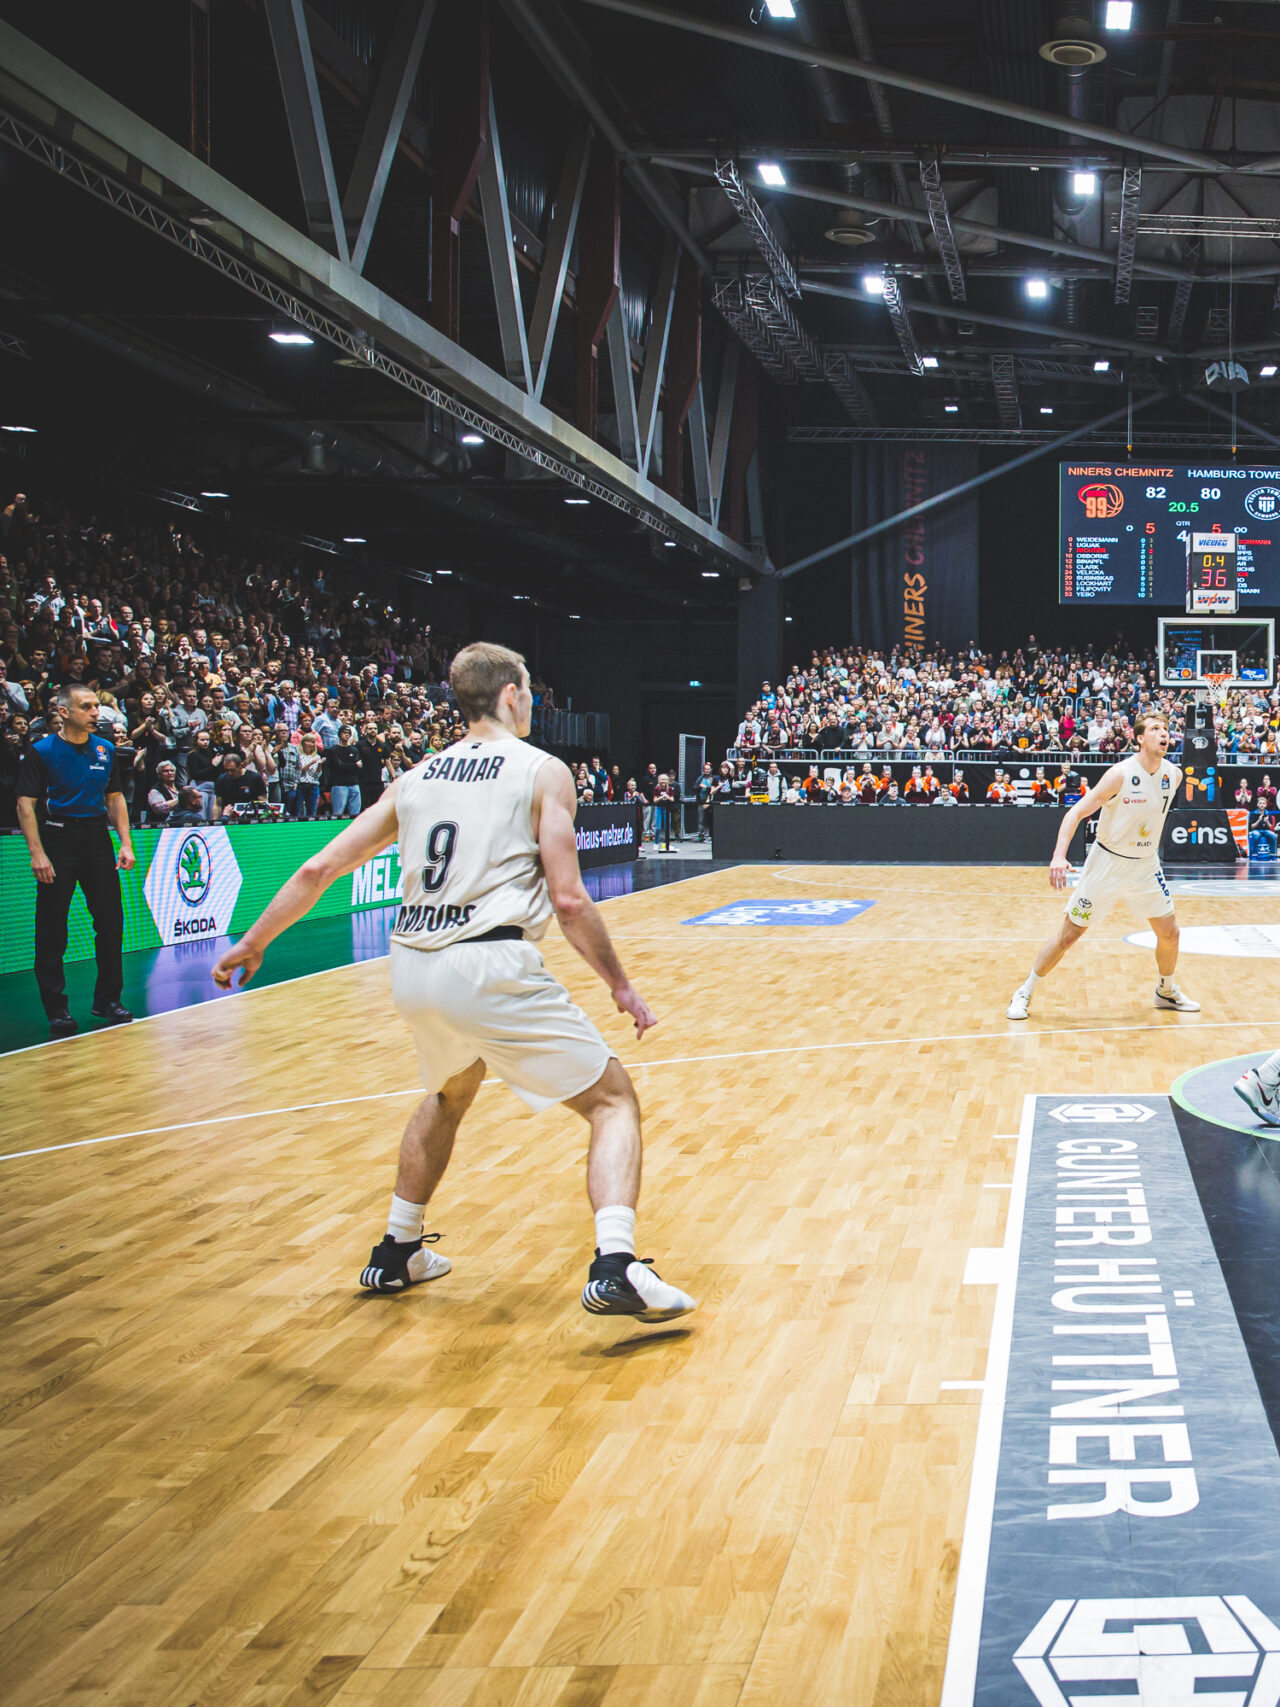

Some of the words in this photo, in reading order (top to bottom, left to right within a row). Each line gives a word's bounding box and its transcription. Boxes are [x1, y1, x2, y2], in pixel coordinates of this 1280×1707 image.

[1068, 467, 1112, 476] NINERS
[1114, 468, 1174, 477] CHEMNITZ
[1187, 469, 1246, 478] HAMBURG
[1146, 487, 1166, 499] 82
[1200, 488, 1221, 500] 80
[1086, 497, 1107, 518] 99
[1168, 502, 1199, 512] 20.5
[1145, 523, 1156, 534] 5
[1177, 530, 1188, 542] 4
[1211, 524, 1222, 534] 5
[1203, 555, 1225, 567] 0.4
[1201, 569, 1227, 587] 36
[423, 756, 505, 783] SAMAR
[1162, 795, 1169, 814] 7
[574, 821, 633, 851] ohaus-melzer.de
[1171, 820, 1228, 845] eins
[422, 821, 459, 893] 9
[174, 916, 217, 937] ŠKODA
[1055, 1138, 1152, 1248] GUNTER
[1046, 1257, 1200, 1521] HÜTTNER
